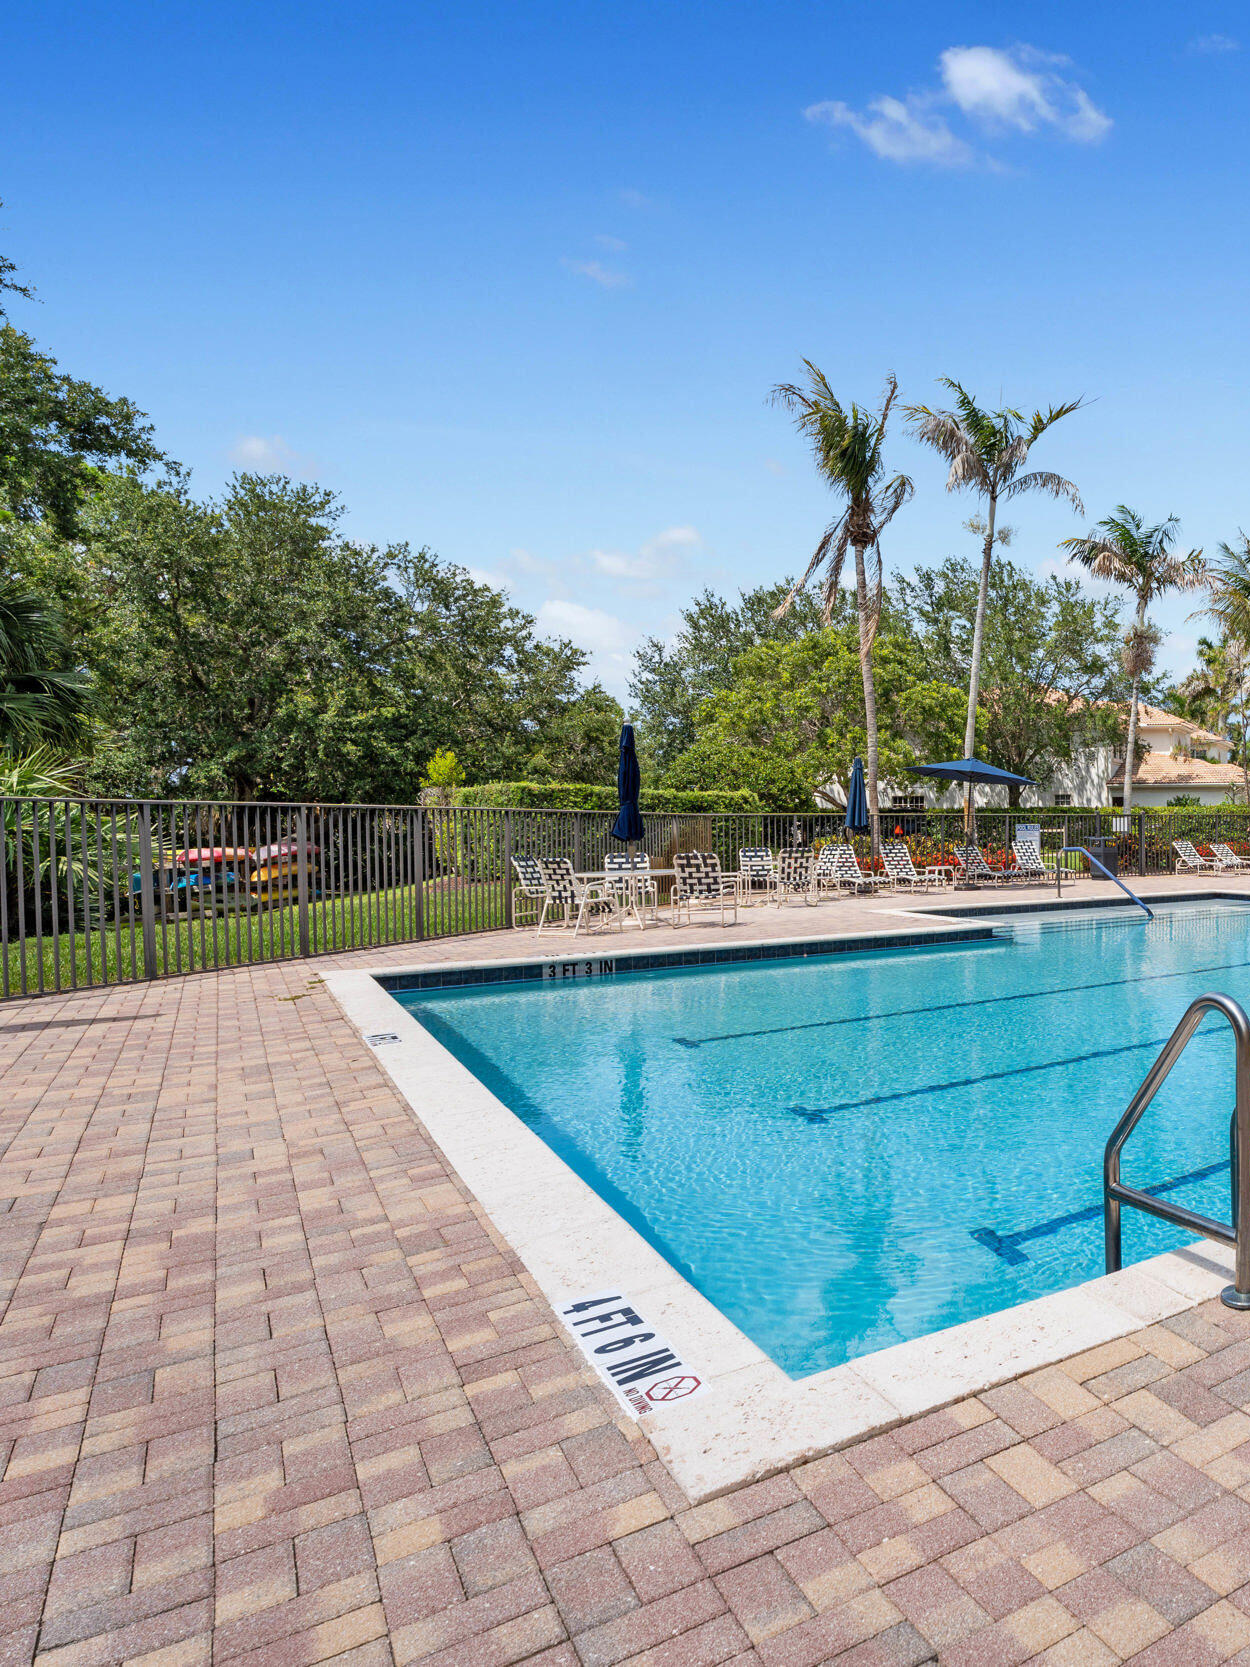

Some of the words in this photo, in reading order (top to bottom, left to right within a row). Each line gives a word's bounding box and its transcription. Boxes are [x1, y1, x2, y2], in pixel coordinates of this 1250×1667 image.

[548, 965, 556, 977] 3
[562, 963, 578, 976] FT
[585, 962, 592, 974] 3
[600, 960, 613, 973] IN
[563, 1295, 622, 1315] 4
[573, 1307, 645, 1337] FT
[594, 1332, 656, 1354] 6
[606, 1347, 683, 1386] IN
[623, 1387, 639, 1397] NO
[628, 1395, 653, 1415] DIVING
